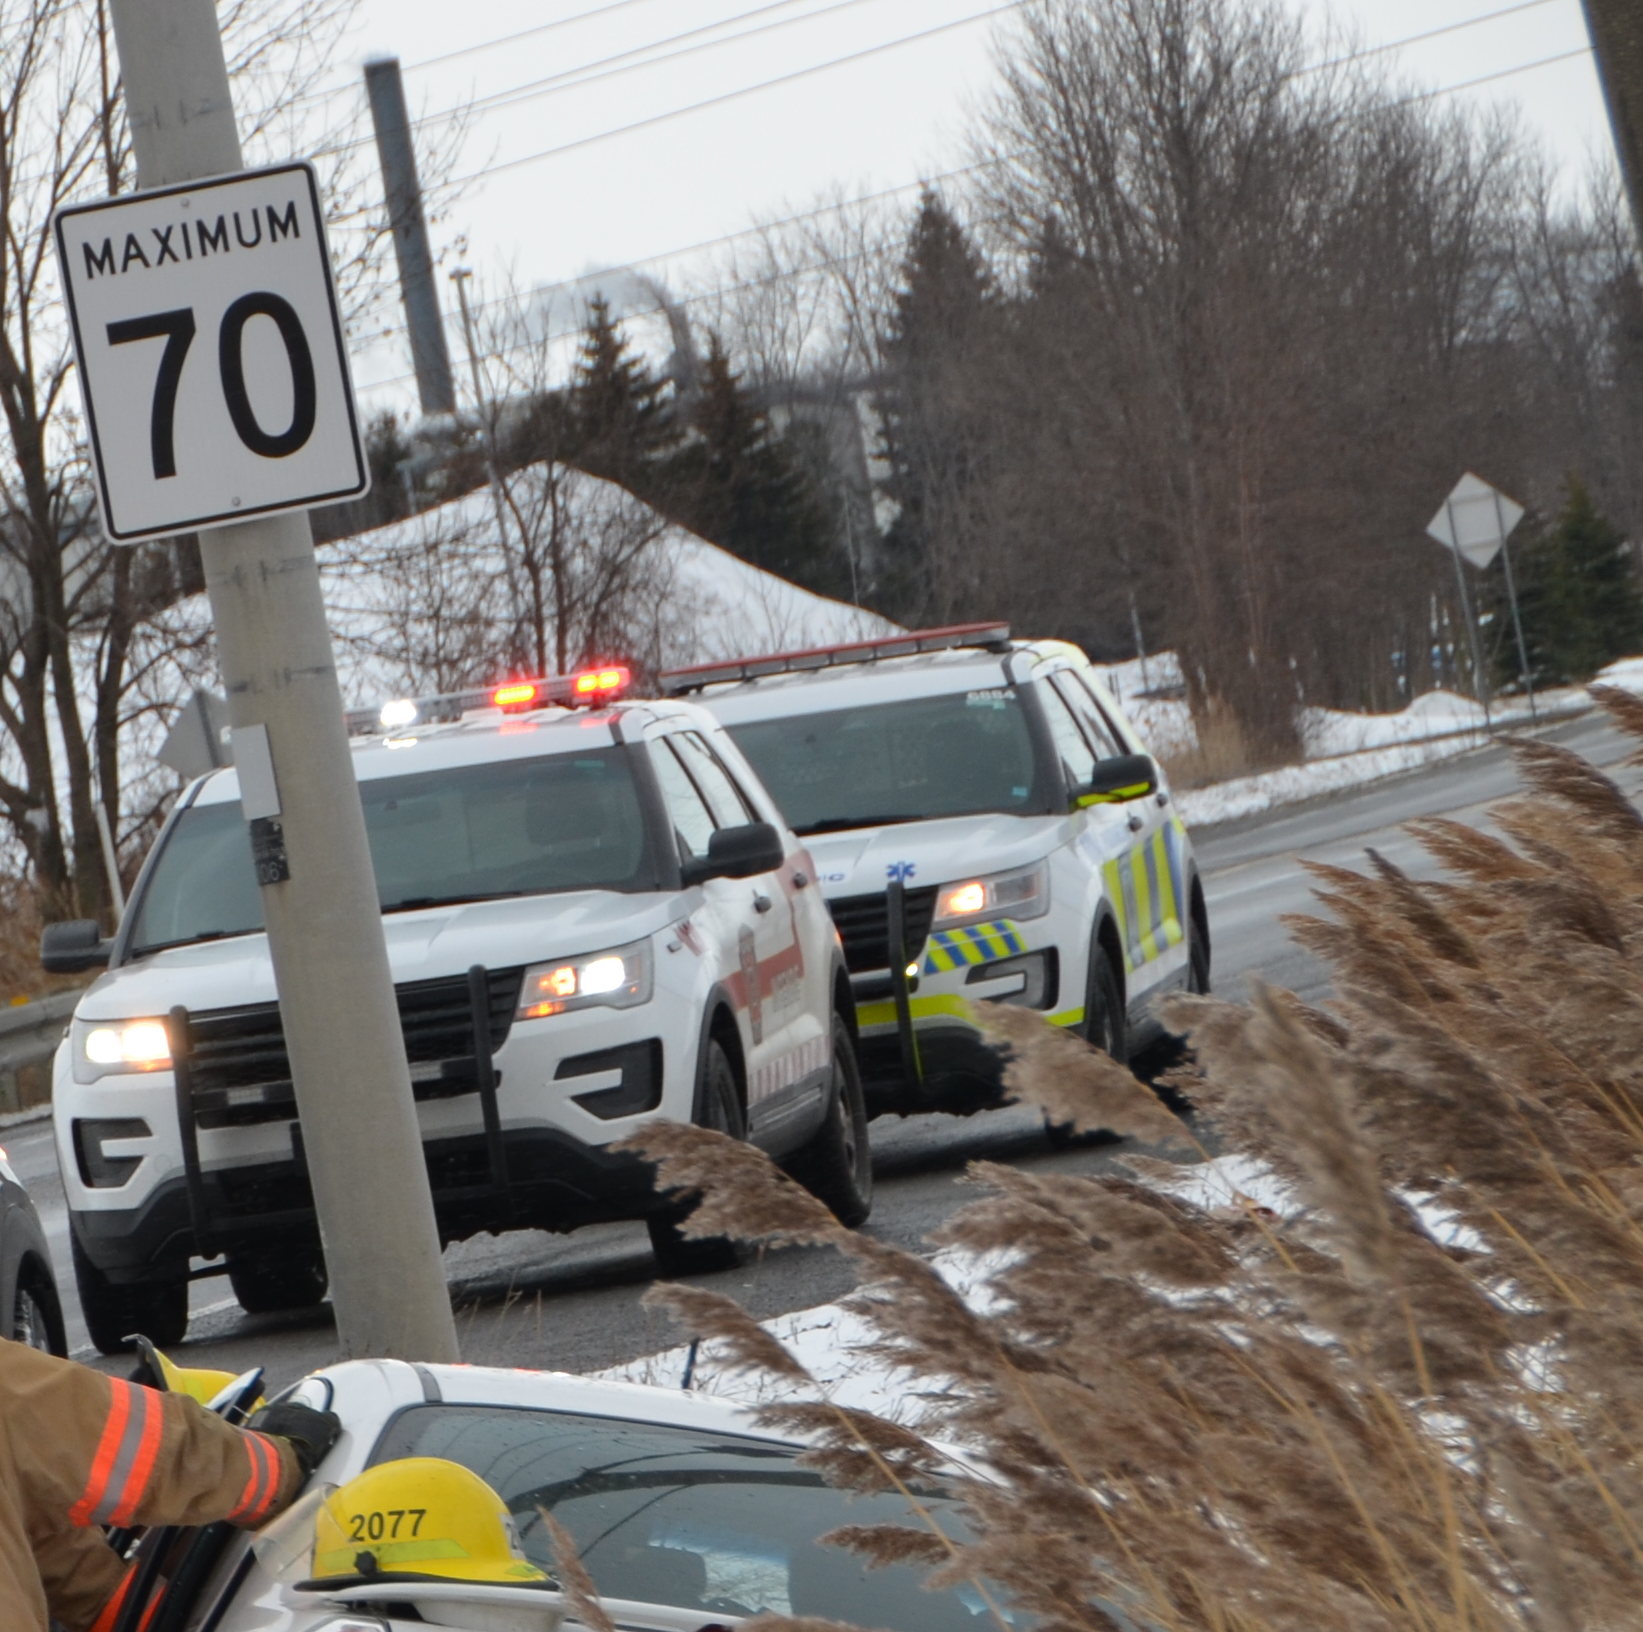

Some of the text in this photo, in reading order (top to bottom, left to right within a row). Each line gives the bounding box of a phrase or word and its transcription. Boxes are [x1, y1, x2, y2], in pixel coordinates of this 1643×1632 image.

[82, 201, 301, 280] MAXIMUM
[105, 291, 317, 480] 70
[348, 1508, 428, 1543] 2077
